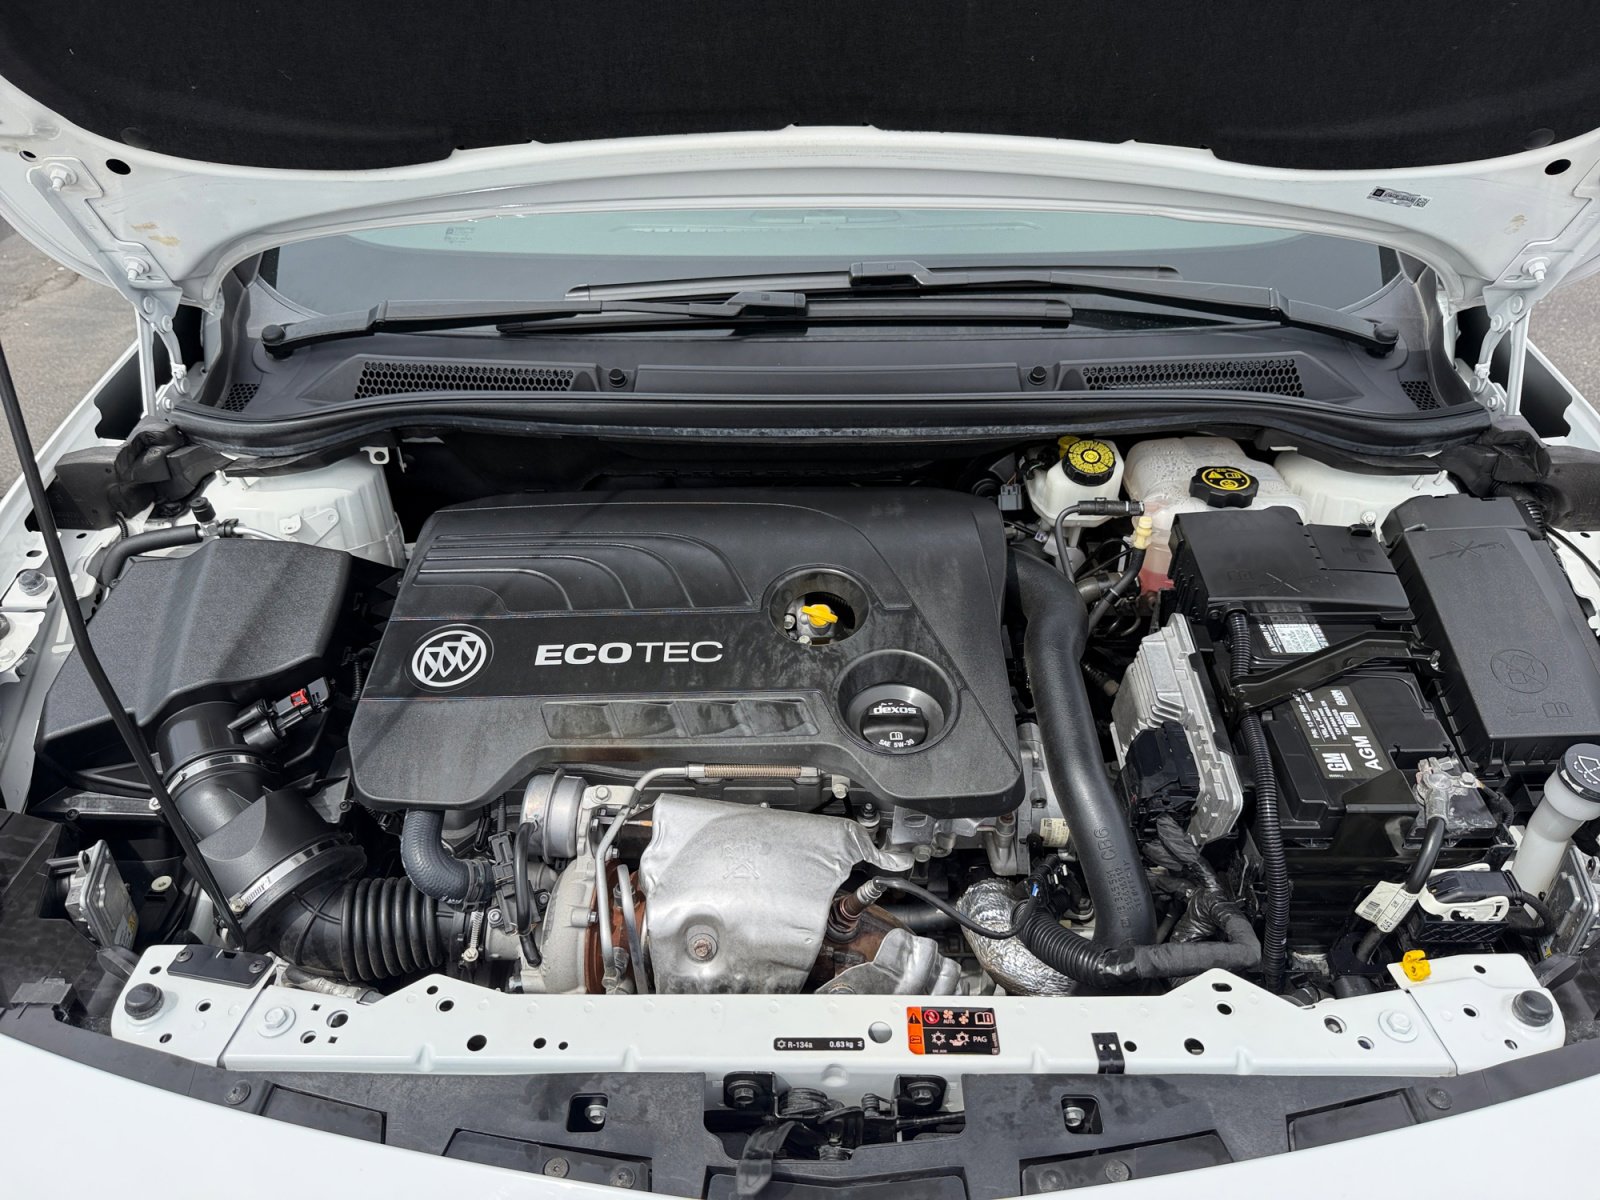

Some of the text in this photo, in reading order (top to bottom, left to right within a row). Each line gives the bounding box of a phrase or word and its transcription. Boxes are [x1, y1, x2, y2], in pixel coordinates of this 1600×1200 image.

[534, 641, 724, 666] ECOTEC
[873, 705, 917, 714] dexos
[1351, 735, 1384, 771] AGM
[1321, 753, 1347, 772] GM
[845, 1041, 854, 1049] kg
[973, 1035, 988, 1043] PAG
